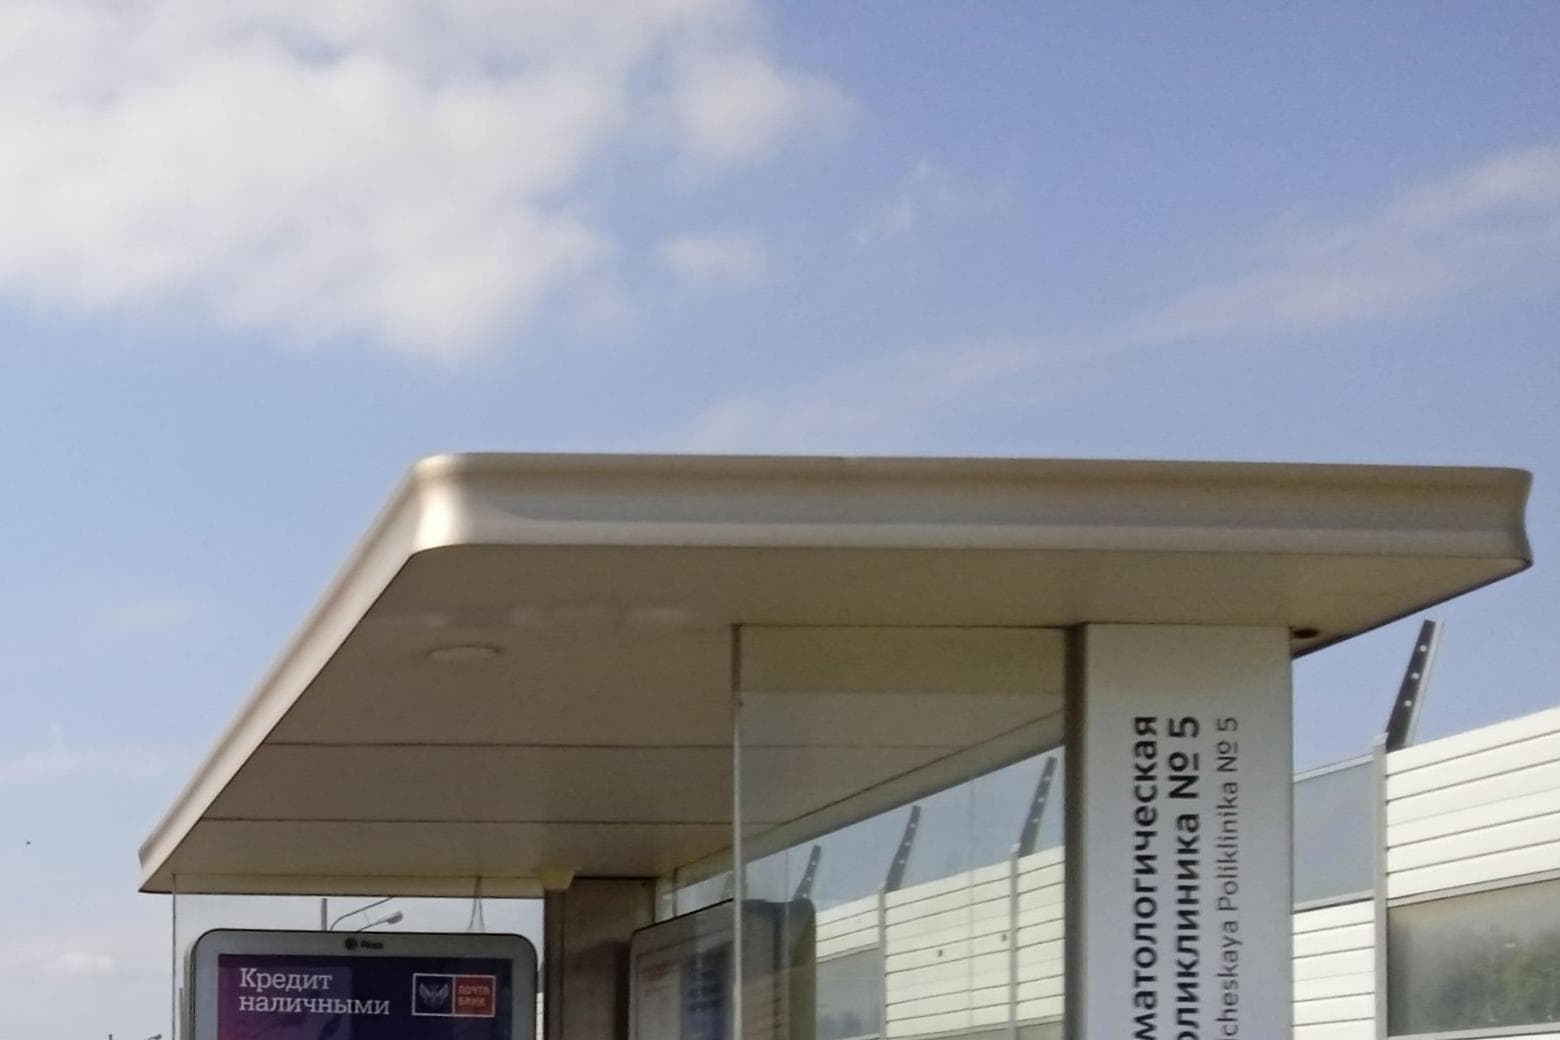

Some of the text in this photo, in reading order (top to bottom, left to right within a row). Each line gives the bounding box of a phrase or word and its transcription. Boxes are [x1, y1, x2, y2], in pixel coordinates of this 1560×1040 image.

[1168, 716, 1200, 738] 5
[1215, 717, 1239, 732] 5
[1215, 781, 1239, 911] Poliklinika
[239, 967, 332, 992] Кредит
[239, 995, 390, 1015] наличными
